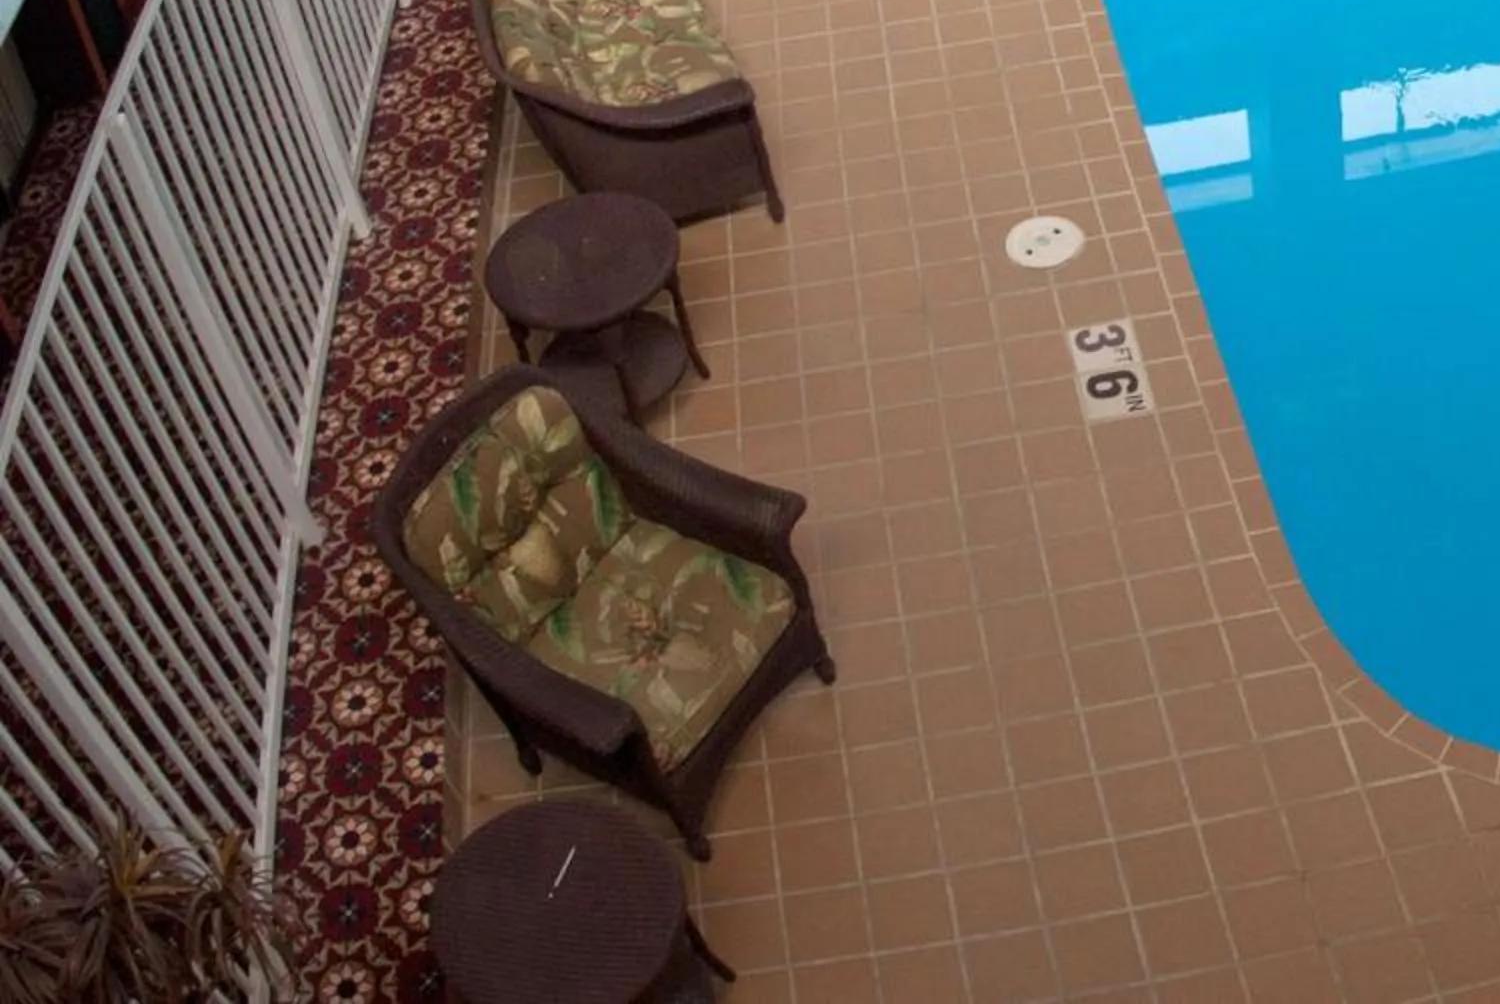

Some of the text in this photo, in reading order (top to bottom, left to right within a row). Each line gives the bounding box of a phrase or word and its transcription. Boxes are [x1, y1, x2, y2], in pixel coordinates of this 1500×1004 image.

[1075, 324, 1147, 413] 3 FT 6 IN
